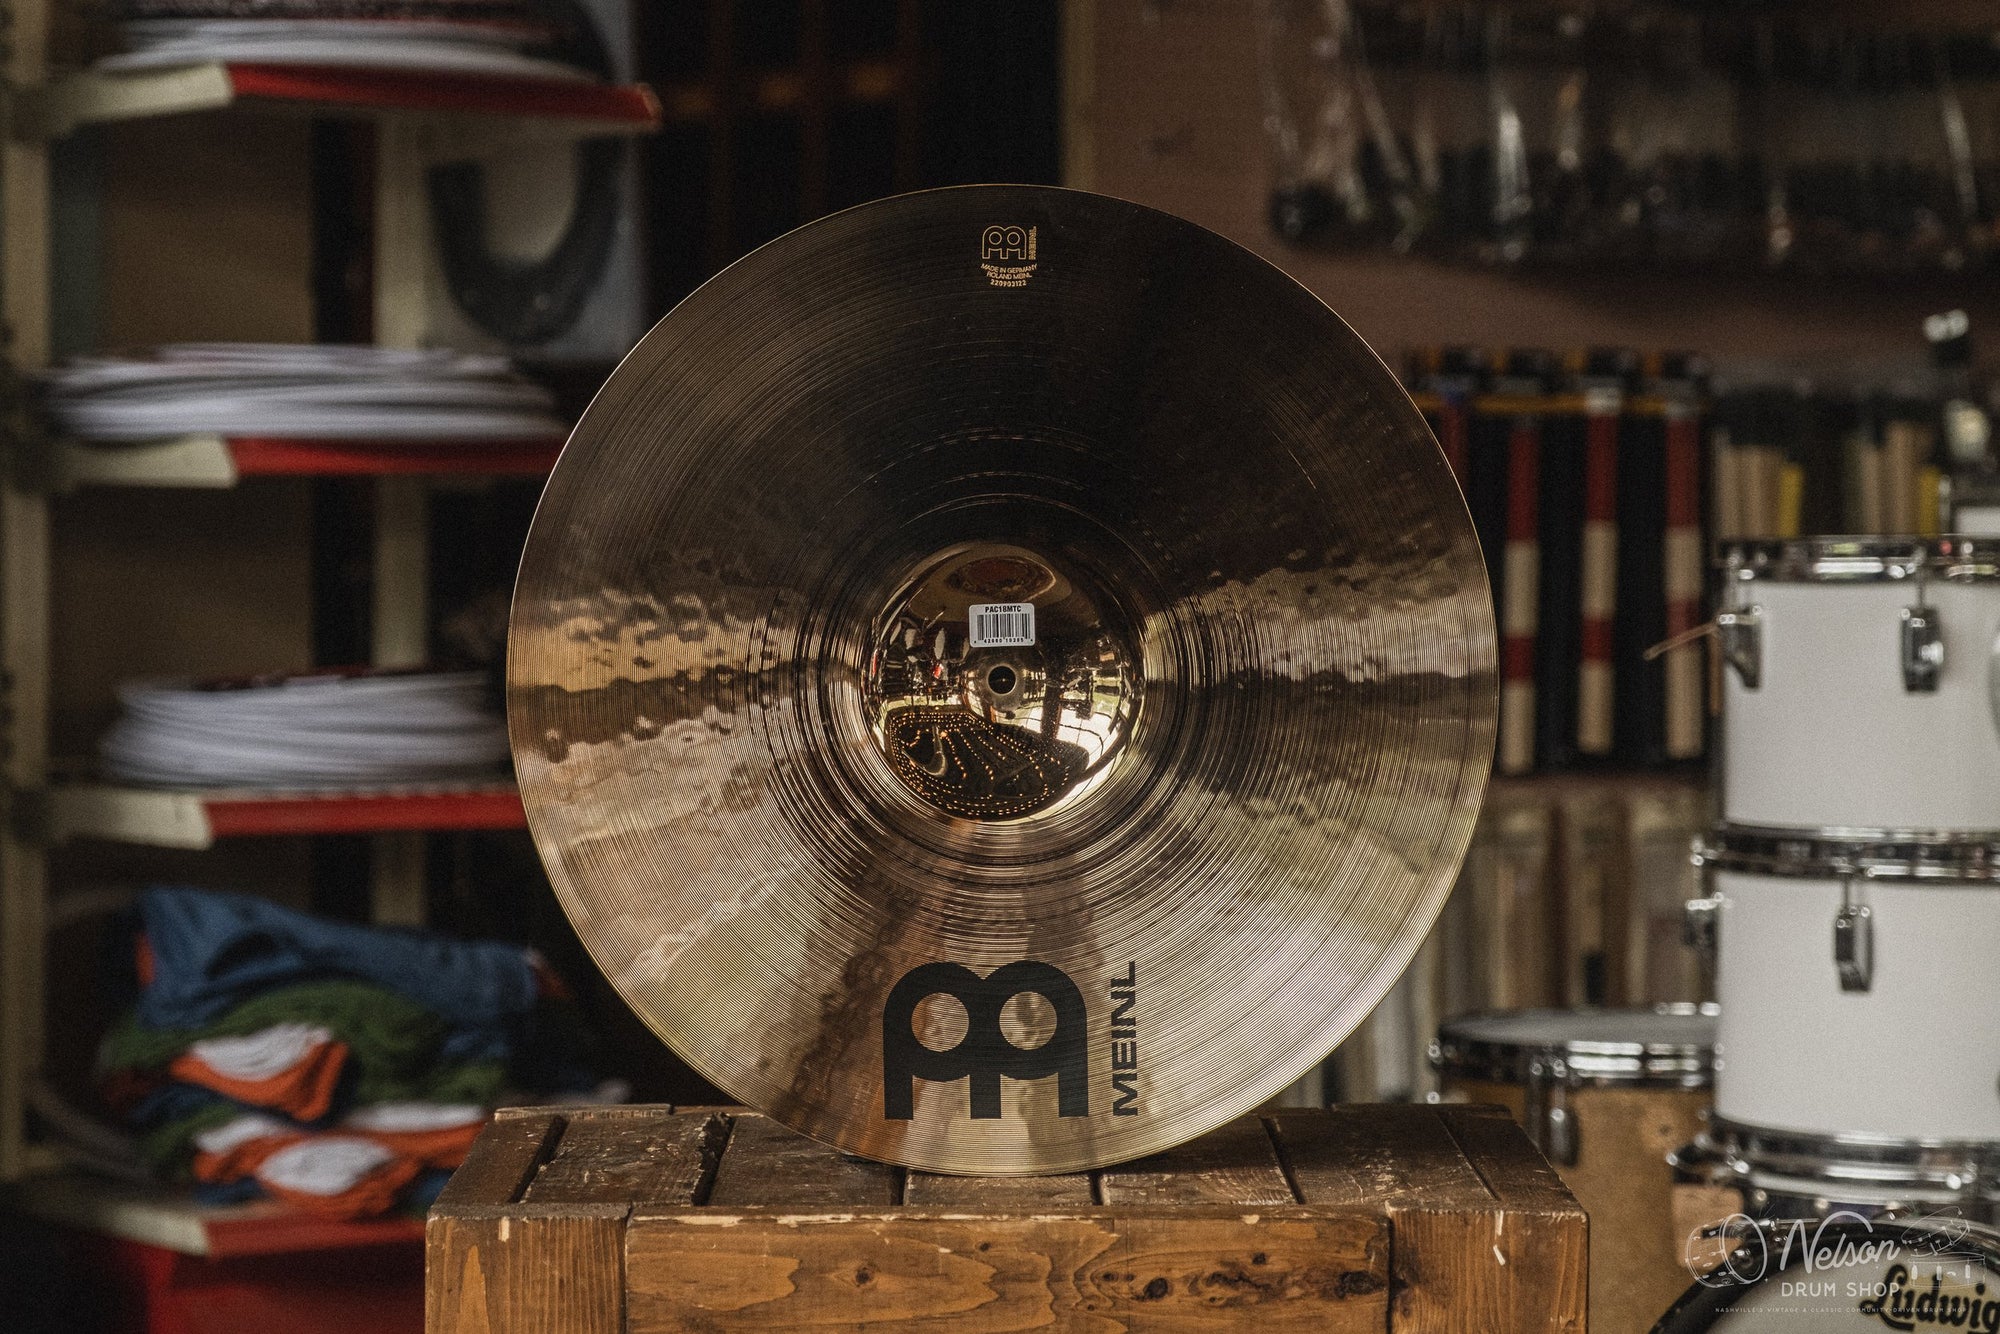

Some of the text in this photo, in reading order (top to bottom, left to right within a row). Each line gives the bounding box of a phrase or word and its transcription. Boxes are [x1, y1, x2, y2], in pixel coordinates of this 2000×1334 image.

[980, 263, 1000, 273] MADE
[1007, 263, 1038, 274] GERMANY
[986, 271, 1012, 280] ROLAND
[985, 605, 1022, 613] PAC18MTC
[1111, 960, 1139, 1117] MEINL
